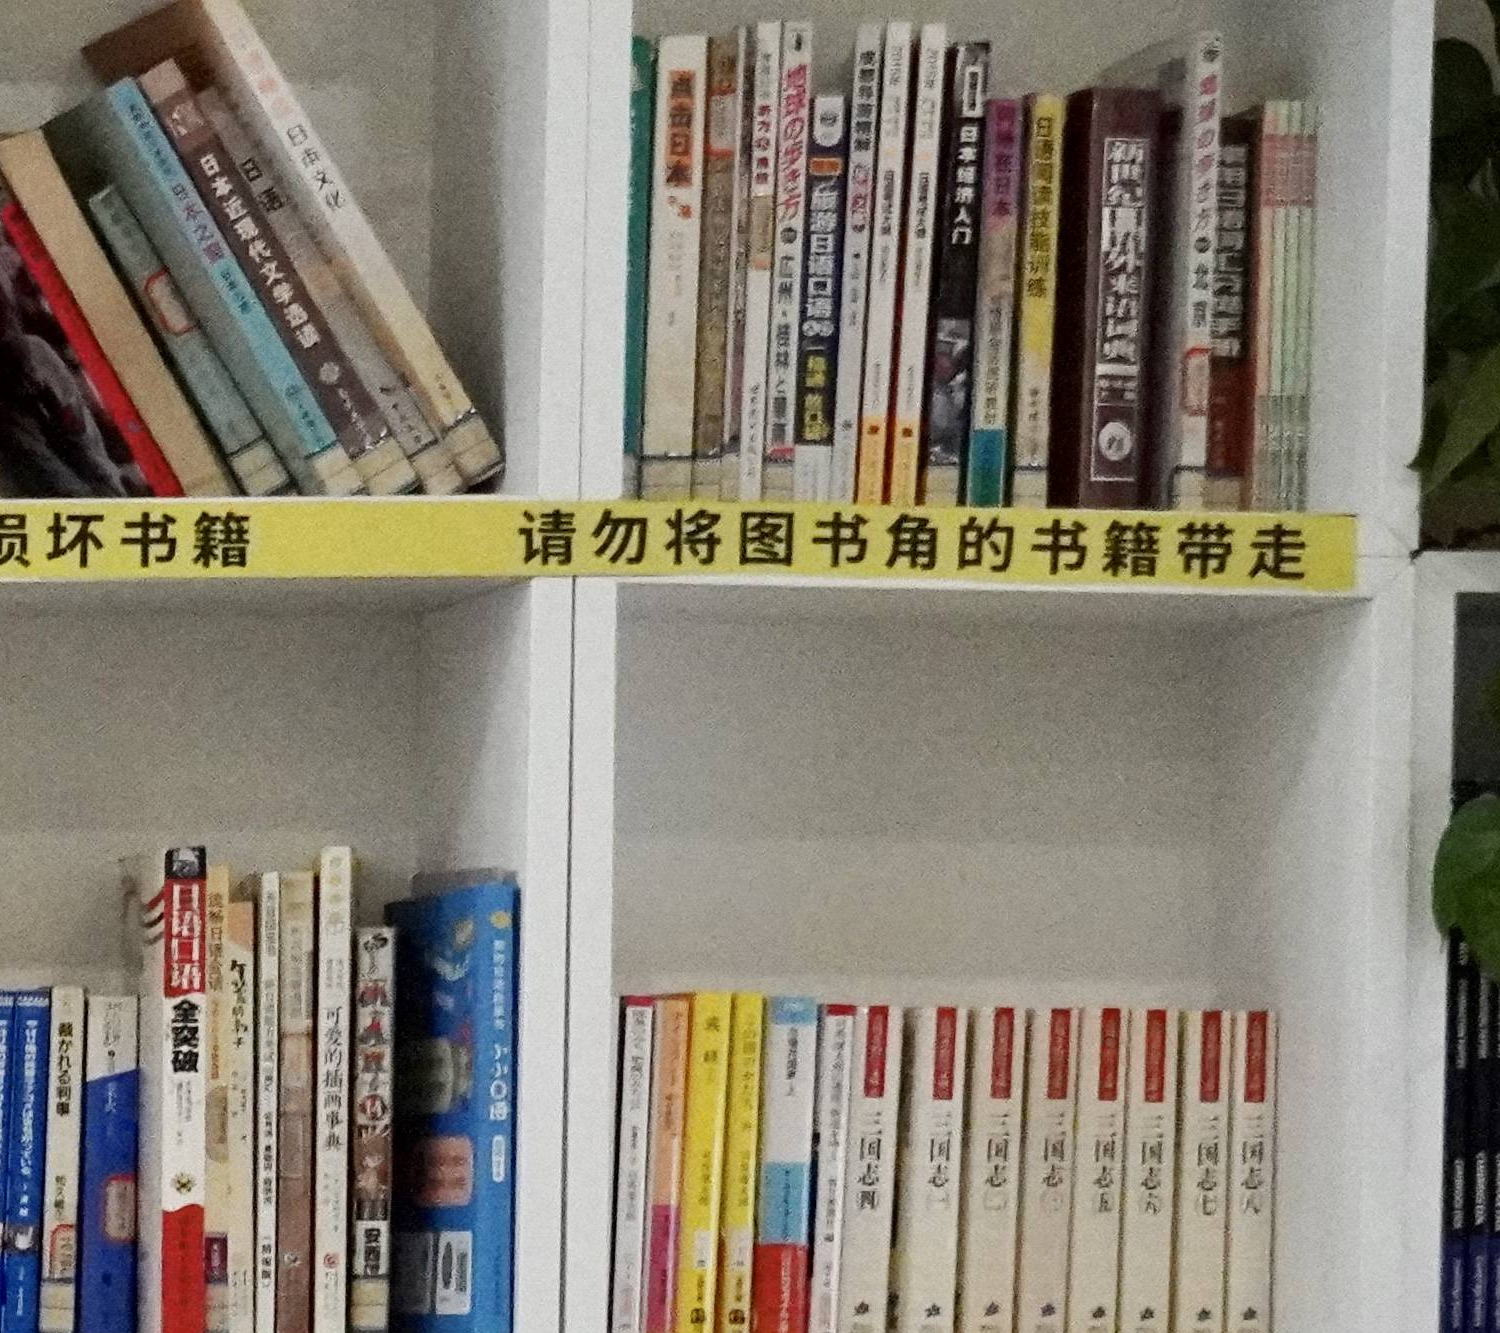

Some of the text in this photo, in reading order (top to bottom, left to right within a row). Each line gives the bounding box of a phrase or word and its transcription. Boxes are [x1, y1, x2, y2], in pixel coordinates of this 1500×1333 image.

[519, 509, 1306, 580] 请勿将图书角的书籍带走
